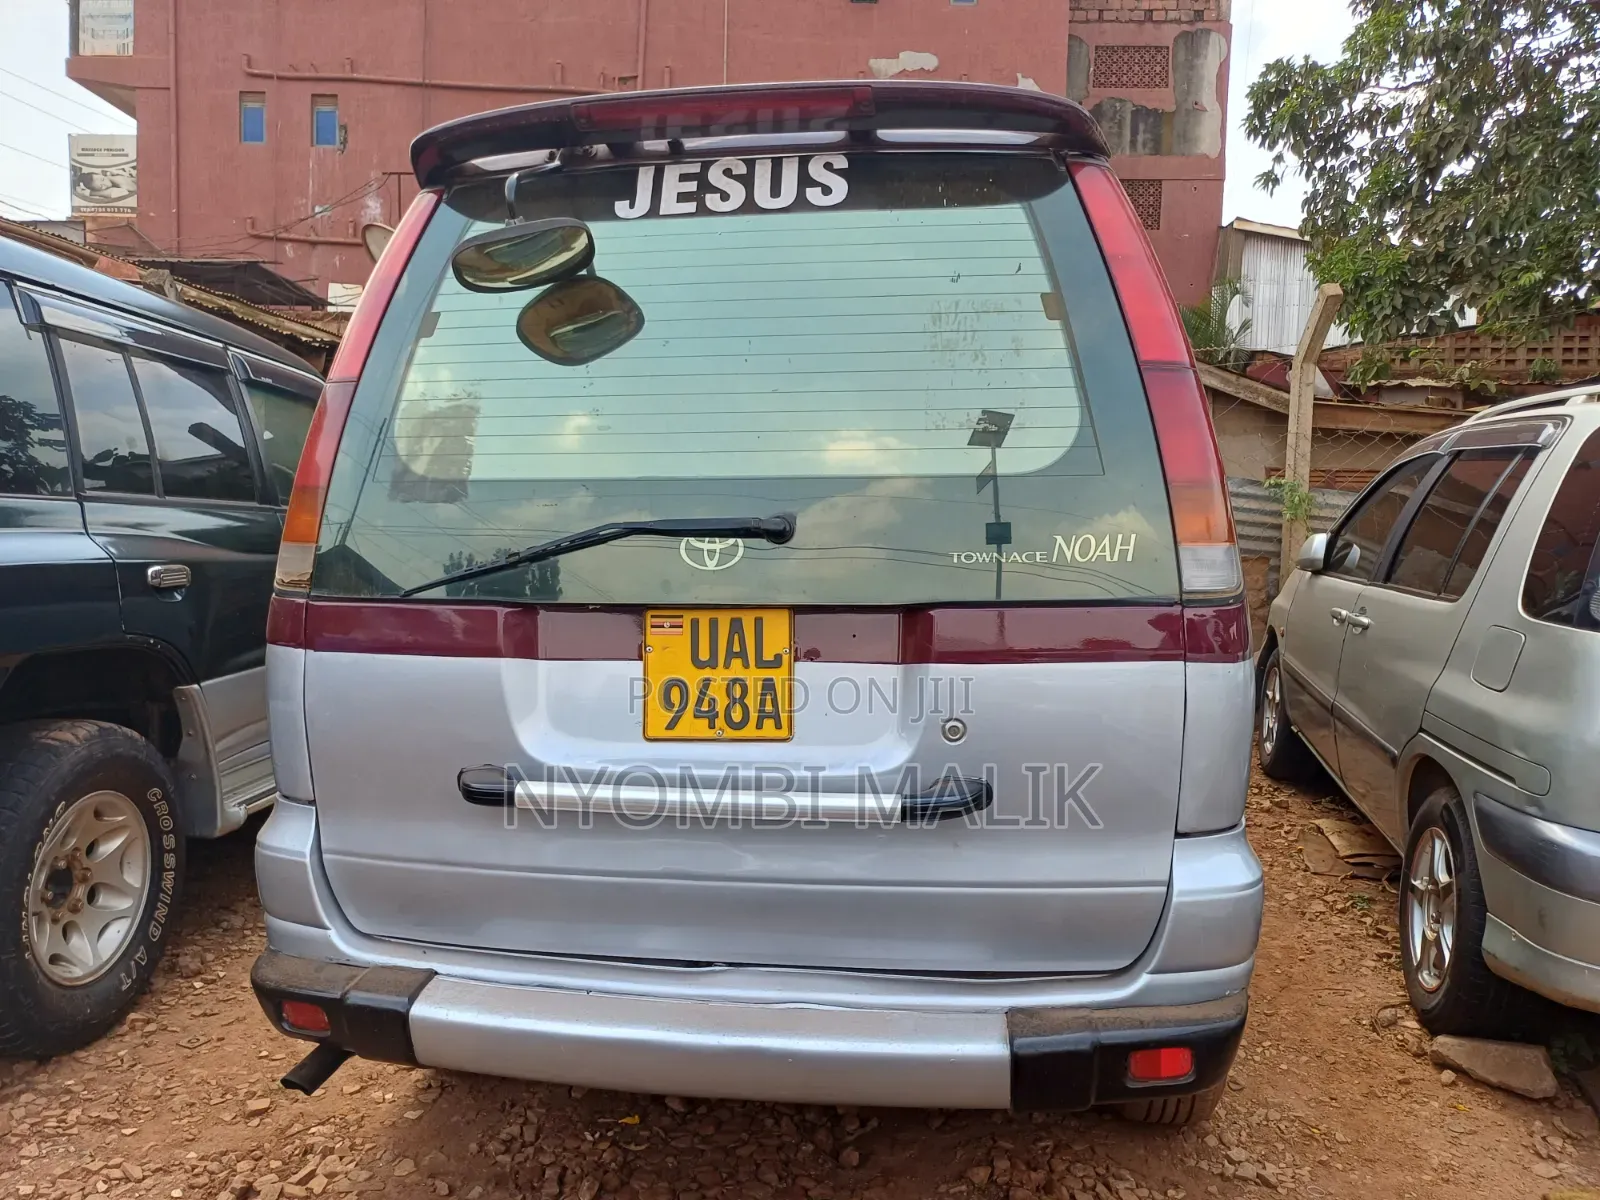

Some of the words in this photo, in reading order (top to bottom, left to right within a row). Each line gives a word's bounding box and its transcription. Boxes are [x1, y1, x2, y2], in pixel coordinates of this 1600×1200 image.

[614, 154, 849, 219] JESUS
[950, 551, 1048, 564] TOWNACE
[1052, 533, 1137, 563] NOAH
[691, 616, 783, 670] UAL
[662, 676, 783, 731] 948A
[147, 787, 176, 942] CROSSWIND
[120, 945, 148, 991] A/T
